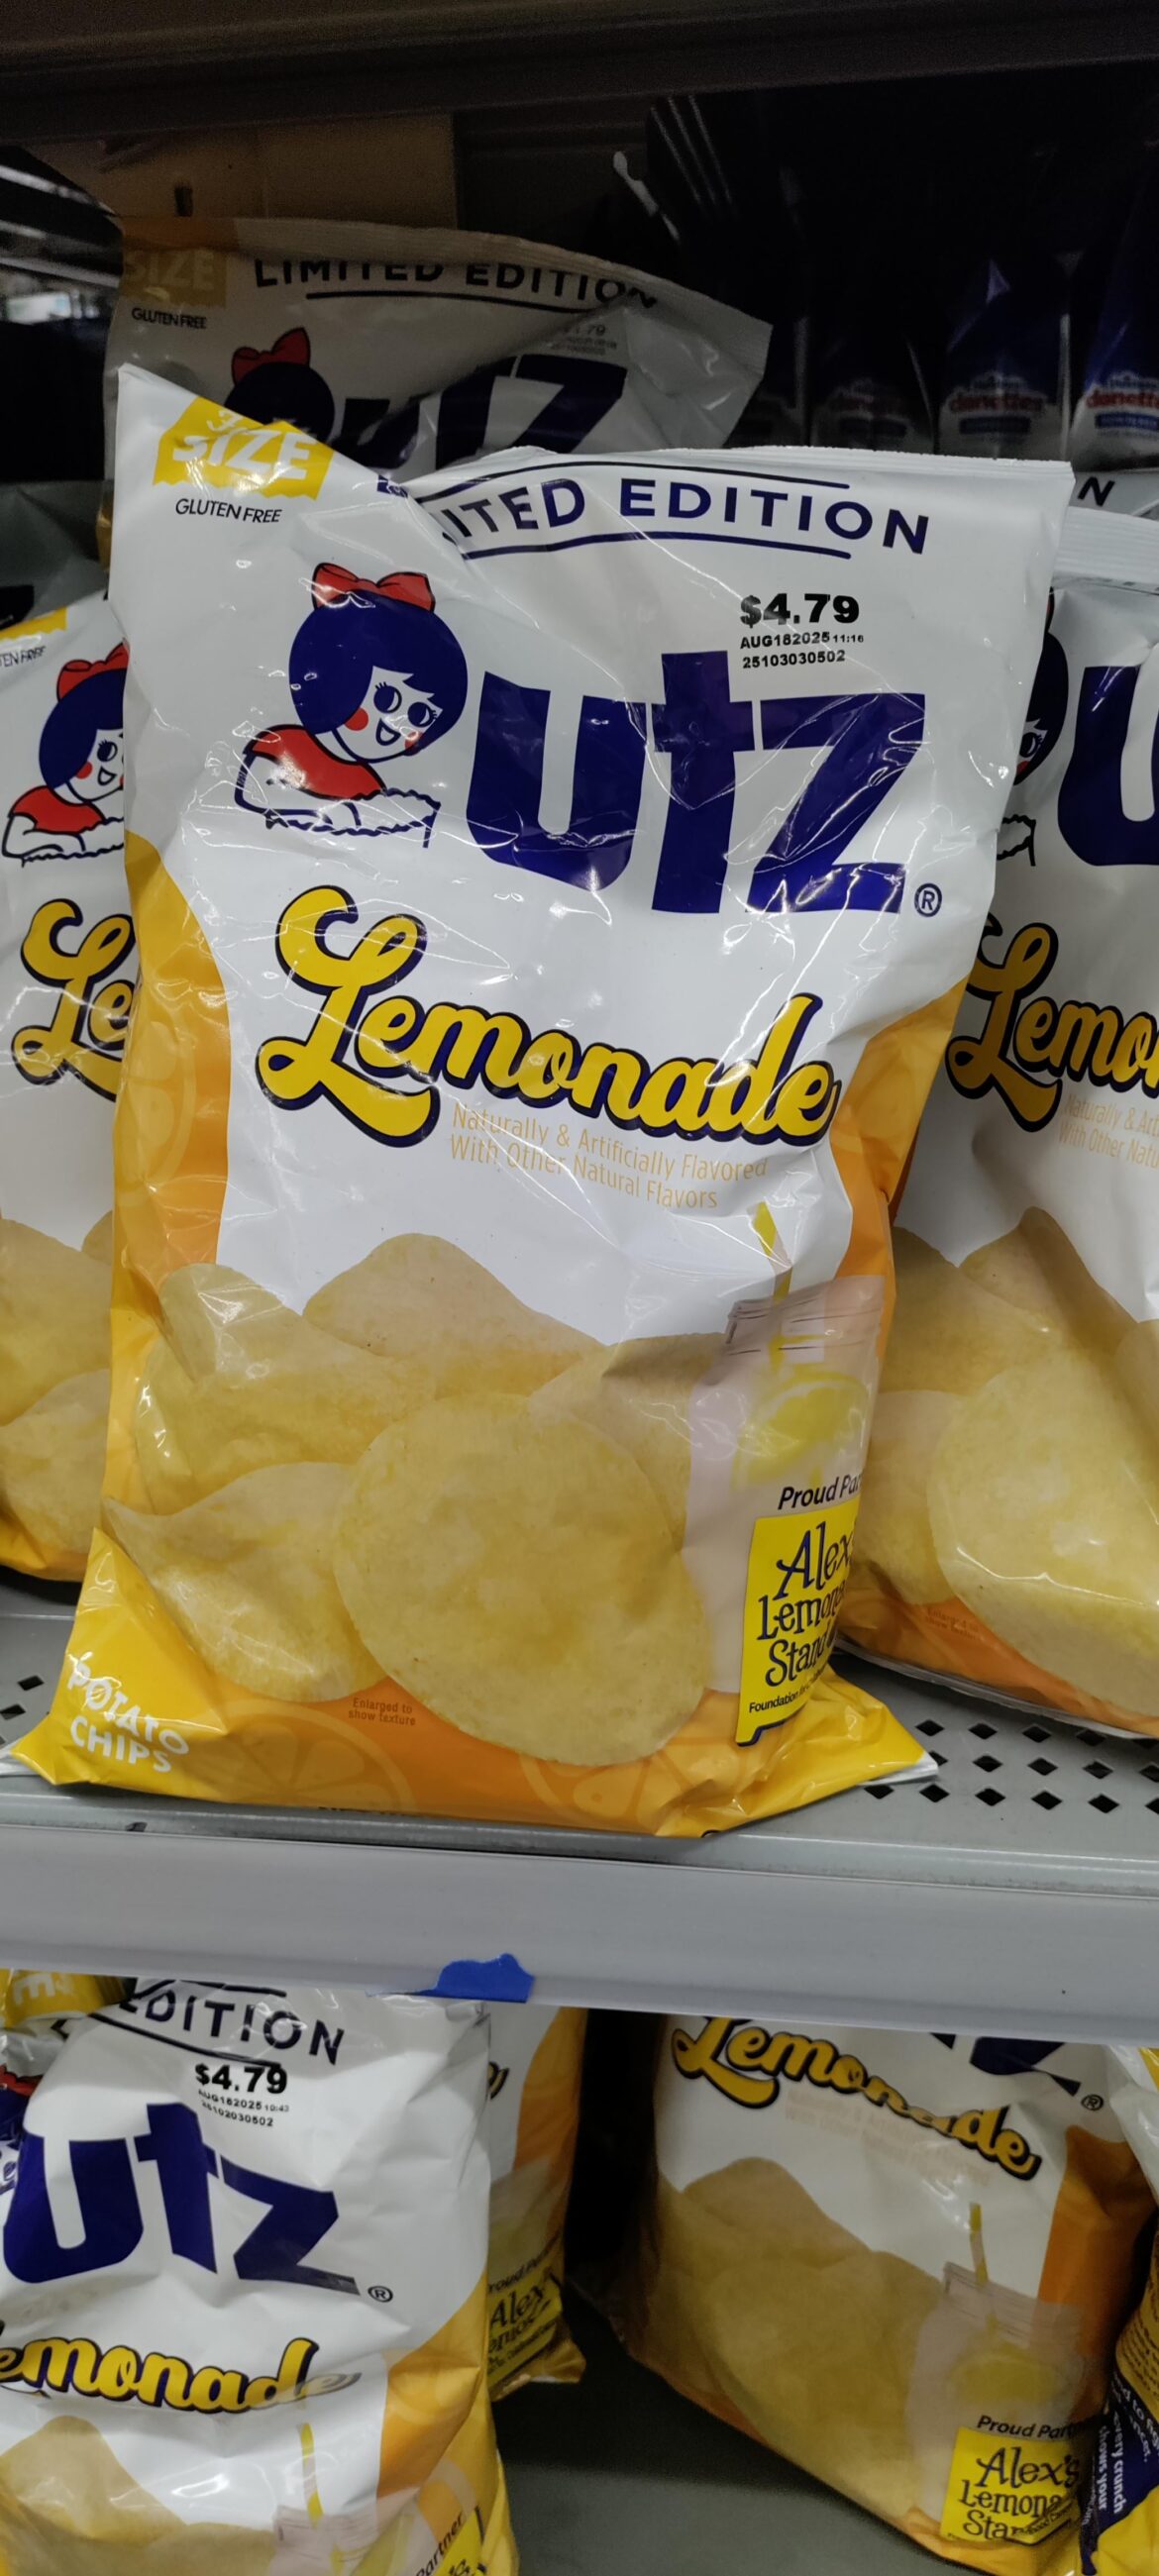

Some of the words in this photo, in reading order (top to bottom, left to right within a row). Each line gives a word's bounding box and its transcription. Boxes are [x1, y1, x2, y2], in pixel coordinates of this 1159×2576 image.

[131, 307, 179, 327] GLUTEN
[179, 315, 207, 329] FREE
[172, 428, 317, 480] SIZE
[175, 497, 242, 521] GLUTEN
[242, 507, 282, 524] FREE
[442, 477, 586, 541] ITED
[620, 477, 929, 555] EDITION
[740, 592, 860, 629] $4.79
[740, 631, 830, 649] AUG182025
[743, 649, 845, 669] 25103030502
[255, 884, 842, 1148] Lemonade
[452, 1102, 549, 1147] Naturally
[556, 1123, 572, 1148] &
[578, 1128, 677, 1180] Artificially
[681, 1154, 769, 1182] Flavored
[450, 1134, 497, 1165] With
[506, 1142, 567, 1176] Other
[573, 1155, 642, 1197] Natural
[646, 1180, 718, 1209] Flavors
[778, 1476, 840, 1510] Proud
[67, 1656, 189, 1754] POTATO
[348, 1708, 376, 1720] show
[379, 1711, 416, 1726] texture
[353, 1697, 398, 1712] Enlarged
[402, 1703, 413, 1714] to
[749, 1691, 798, 1713] Foundation
[70, 1715, 171, 1773] CHIPS
[194, 2062, 288, 2094] $4.79
[977, 2415, 1037, 2437] Proud
[1097, 2473, 1109, 2512] your
[1112, 2459, 1127, 2515] crunch
